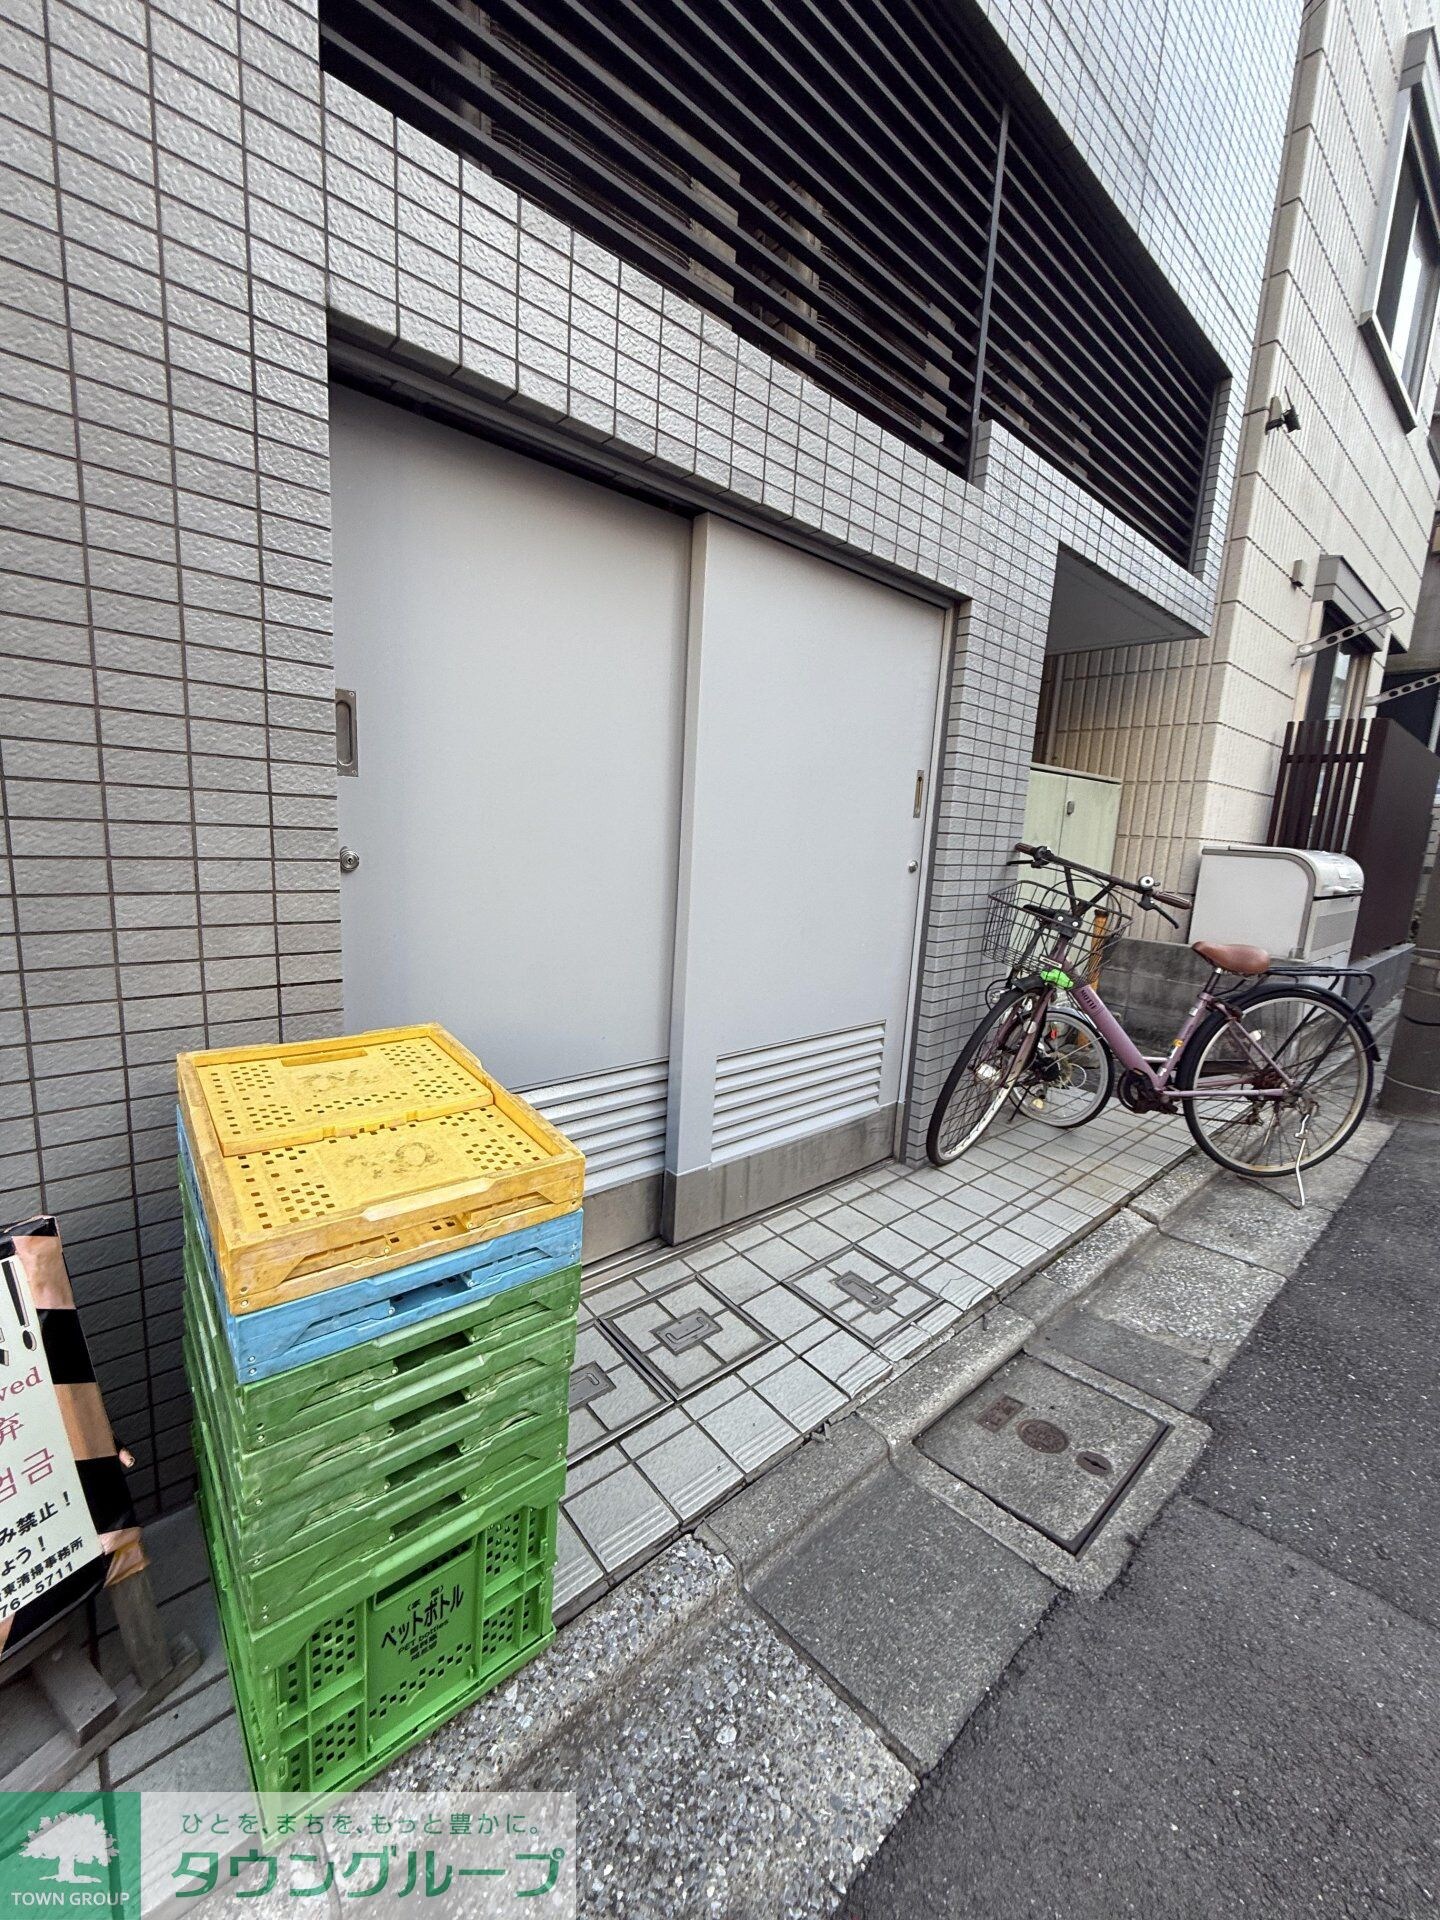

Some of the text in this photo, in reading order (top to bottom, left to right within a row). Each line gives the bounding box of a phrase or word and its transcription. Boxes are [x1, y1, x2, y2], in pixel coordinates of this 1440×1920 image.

[0, 1536, 84, 1602] 東清掃事務所
[381, 1584, 464, 1648] ペットボトル
